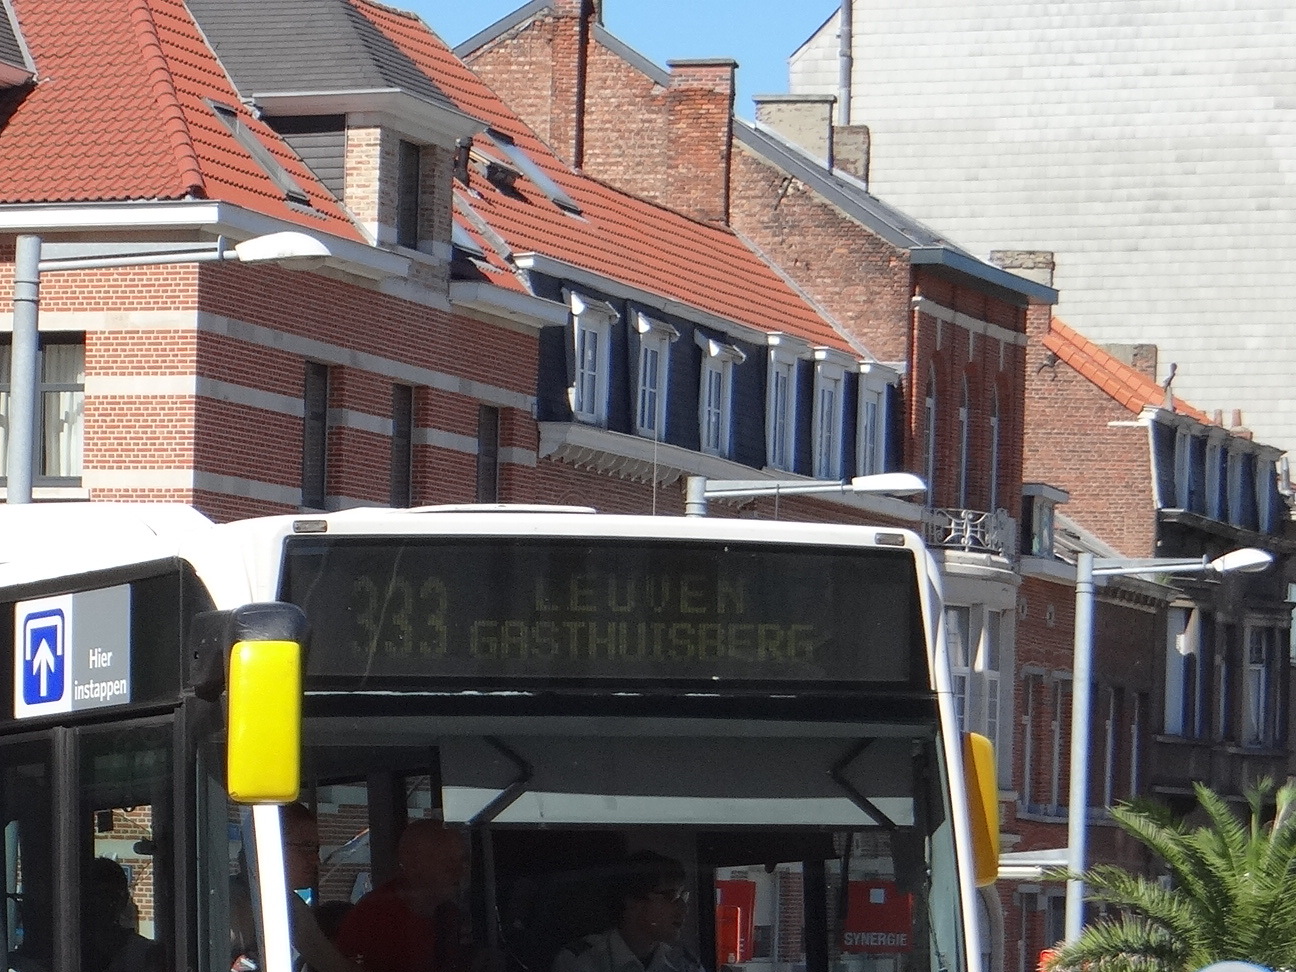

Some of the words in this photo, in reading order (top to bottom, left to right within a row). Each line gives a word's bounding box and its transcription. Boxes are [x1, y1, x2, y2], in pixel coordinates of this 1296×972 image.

[535, 574, 746, 614] LEUVEN
[352, 575, 448, 656] 333
[89, 648, 113, 669] Hier
[74, 679, 127, 702] instappen
[843, 932, 908, 947] SYNERGIE
